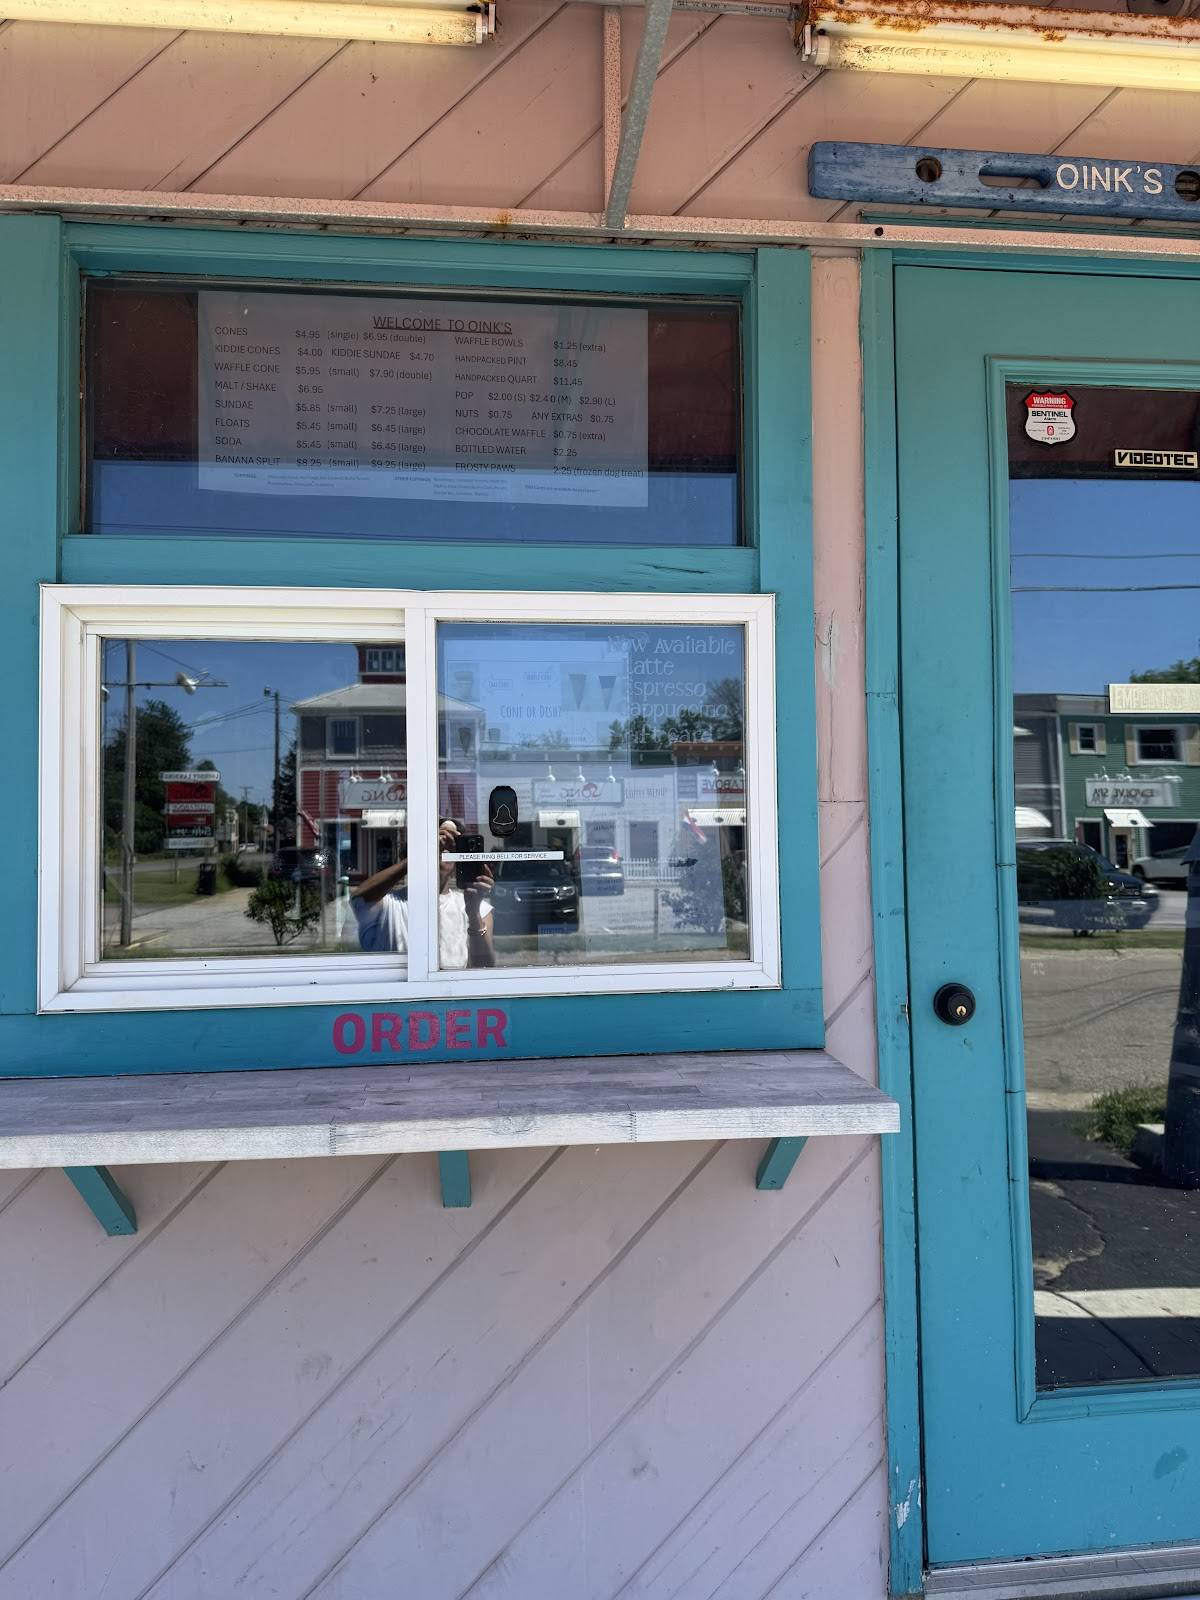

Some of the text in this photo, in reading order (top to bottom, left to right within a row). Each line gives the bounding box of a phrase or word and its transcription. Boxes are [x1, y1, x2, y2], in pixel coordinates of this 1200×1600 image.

[1055, 162, 1164, 195] OINK'S
[373, 315, 512, 333] WELCOME TO OINK'S
[214, 326, 426, 344] CONES $4.95 (single) $6.95 (double)
[214, 343, 435, 362] KIDDIE CONES $4.00 KIDDIE SUNDAE $4.70
[454, 336, 606, 352] WAFFLE BOWLS $1.25 (extra)
[455, 354, 506, 365] HANDPACKED
[507, 356, 527, 366] PINT
[214, 362, 251, 372] WAFFLE
[252, 364, 280, 374] CONE
[328, 366, 360, 377] (small)
[396, 370, 433, 381] (double)
[455, 373, 583, 386] HANDPACKED QUART $11.45
[214, 380, 239, 390] MALT
[246, 382, 277, 392] SHAKE
[297, 384, 324, 394] $6.95
[455, 390, 475, 400] POP
[487, 391, 513, 401] $2.00
[214, 399, 255, 410] SUNDAE
[327, 403, 358, 414] (small)
[370, 405, 397, 415] $7.25
[398, 407, 426, 418] (large)
[1033, 396, 1067, 405] WARNING
[455, 408, 615, 424] NUTS $0.75 ANY EXTRAS $0.75
[1031, 410, 1069, 418] SENTINEL
[214, 417, 426, 436] FLOATS $5.45 (small) $6.45 (large)
[455, 426, 606, 442] CHOCOLATE WAFFLE $0.75 (extra)
[214, 436, 426, 454] SODA $5.45 (small) $6.45 (large)
[455, 444, 578, 457] BOTTLED WATER $2.25
[214, 454, 255, 465] BANANA
[256, 456, 281, 466] SPLIT
[328, 458, 360, 469] (small)
[398, 461, 426, 472] (large)
[455, 462, 489, 472] FROSTY
[490, 463, 517, 473] PAWS
[1117, 451, 1195, 467] VIDEOTEC
[607, 634, 736, 655] Now Available
[627, 658, 675, 676] atte
[332, 1008, 508, 1054] ORDER
